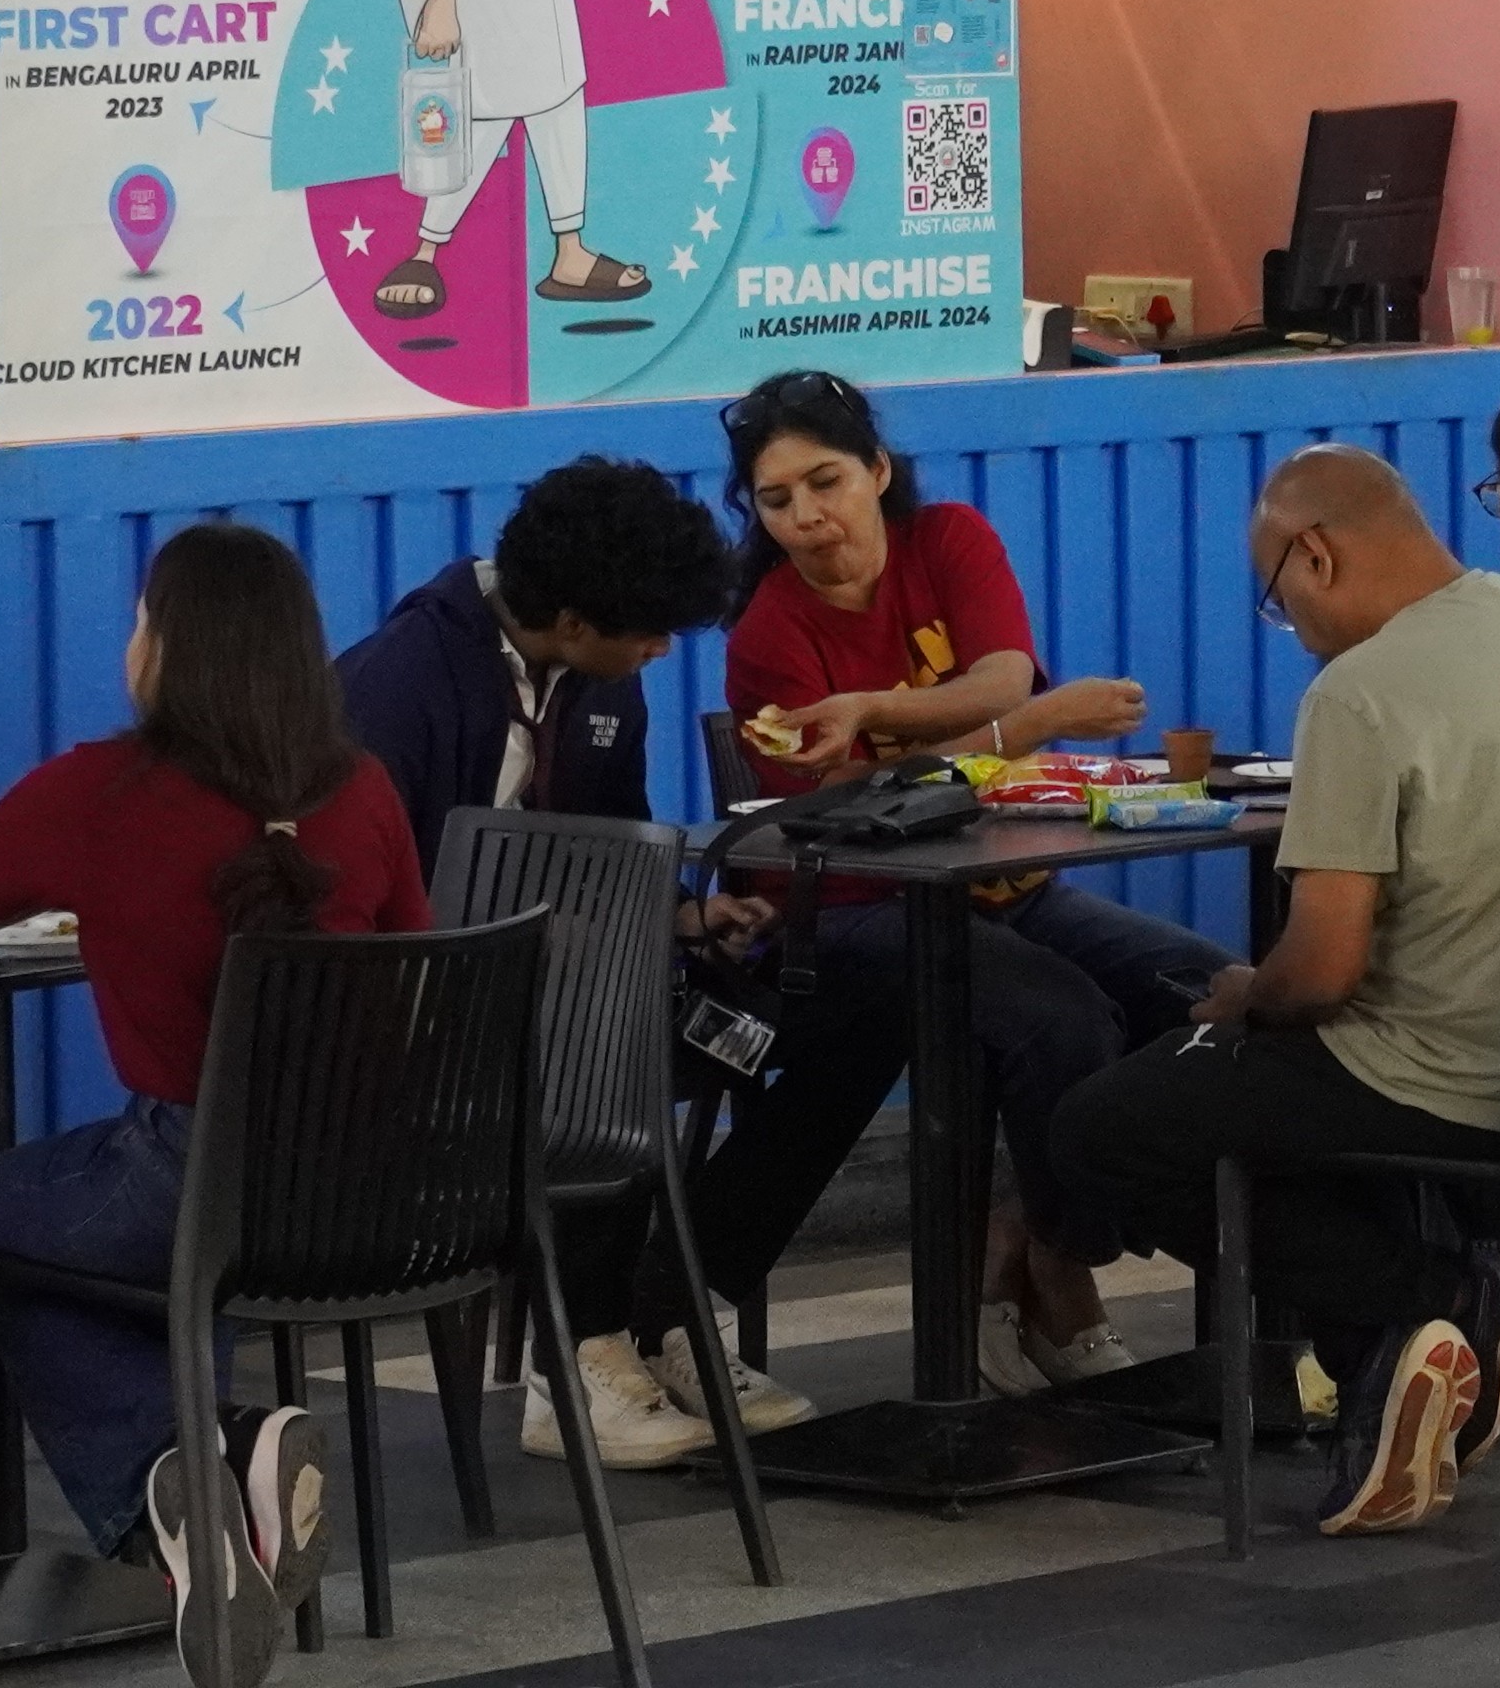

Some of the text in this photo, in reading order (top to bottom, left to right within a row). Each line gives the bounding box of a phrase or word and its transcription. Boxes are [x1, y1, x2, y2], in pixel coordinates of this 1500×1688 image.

[143, 1, 278, 46] CART
[764, 42, 850, 67] RAIPUR
[4, 59, 261, 89] IN BENGALURU APRIL
[827, 74, 882, 97] 2024
[914, 79, 978, 98] Scan for
[105, 96, 164, 119] 2023
[900, 215, 997, 237] INSTAGRAM
[737, 254, 992, 309] FRANCHISE
[85, 294, 203, 341] 2022
[756, 305, 991, 339] KASHMIR APRIL 2024
[82, 346, 302, 380] KITCHEN LAUNCH
